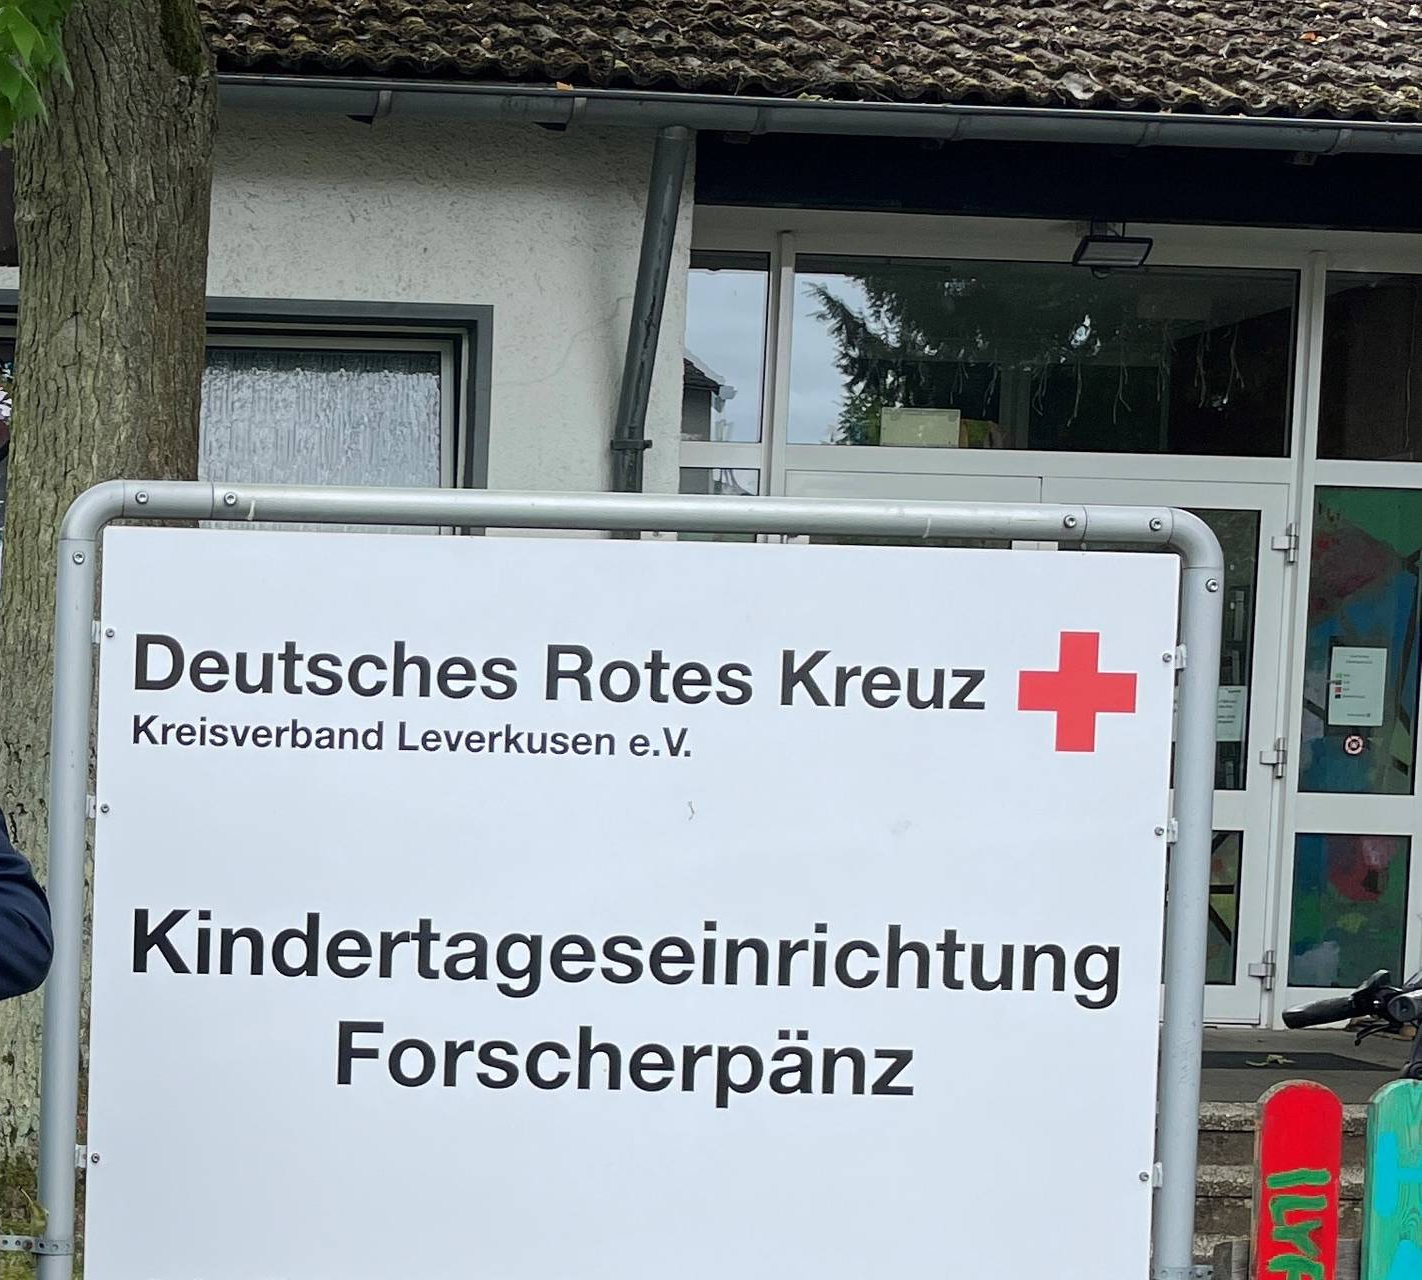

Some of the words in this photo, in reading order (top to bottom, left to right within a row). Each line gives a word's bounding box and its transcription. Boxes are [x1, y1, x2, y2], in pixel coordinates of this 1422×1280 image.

[134, 633, 518, 700] Deutsches
[545, 644, 754, 706] Rotes
[780, 649, 985, 710] Kreuz
[132, 714, 382, 751] Kreisverband
[398, 721, 615, 756] Leverkusen
[629, 727, 692, 757] e.V.
[132, 908, 1120, 1010] Kindertageseinrichtung
[336, 1018, 914, 1109] Forscherpänz
